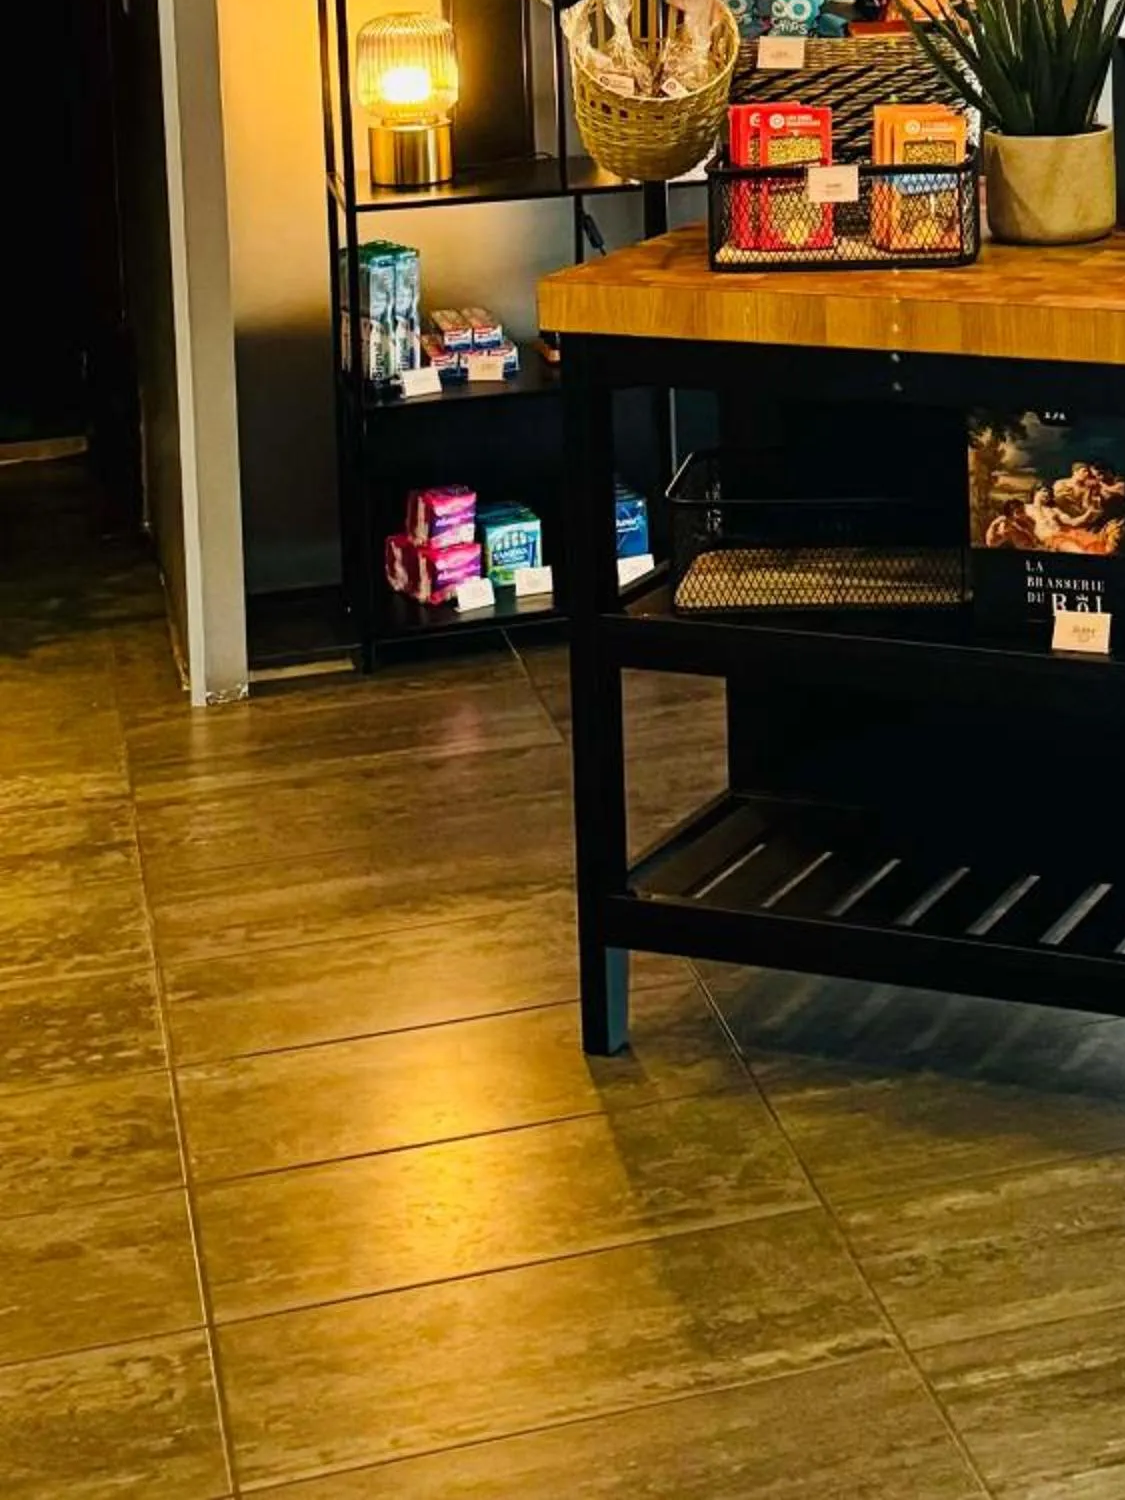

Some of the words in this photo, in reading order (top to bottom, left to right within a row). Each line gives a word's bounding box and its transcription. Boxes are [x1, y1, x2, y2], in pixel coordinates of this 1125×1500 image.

[1025, 559, 1045, 573] LA
[1026, 575, 1106, 593] BRASSERIE
[1026, 591, 1045, 604] DU
